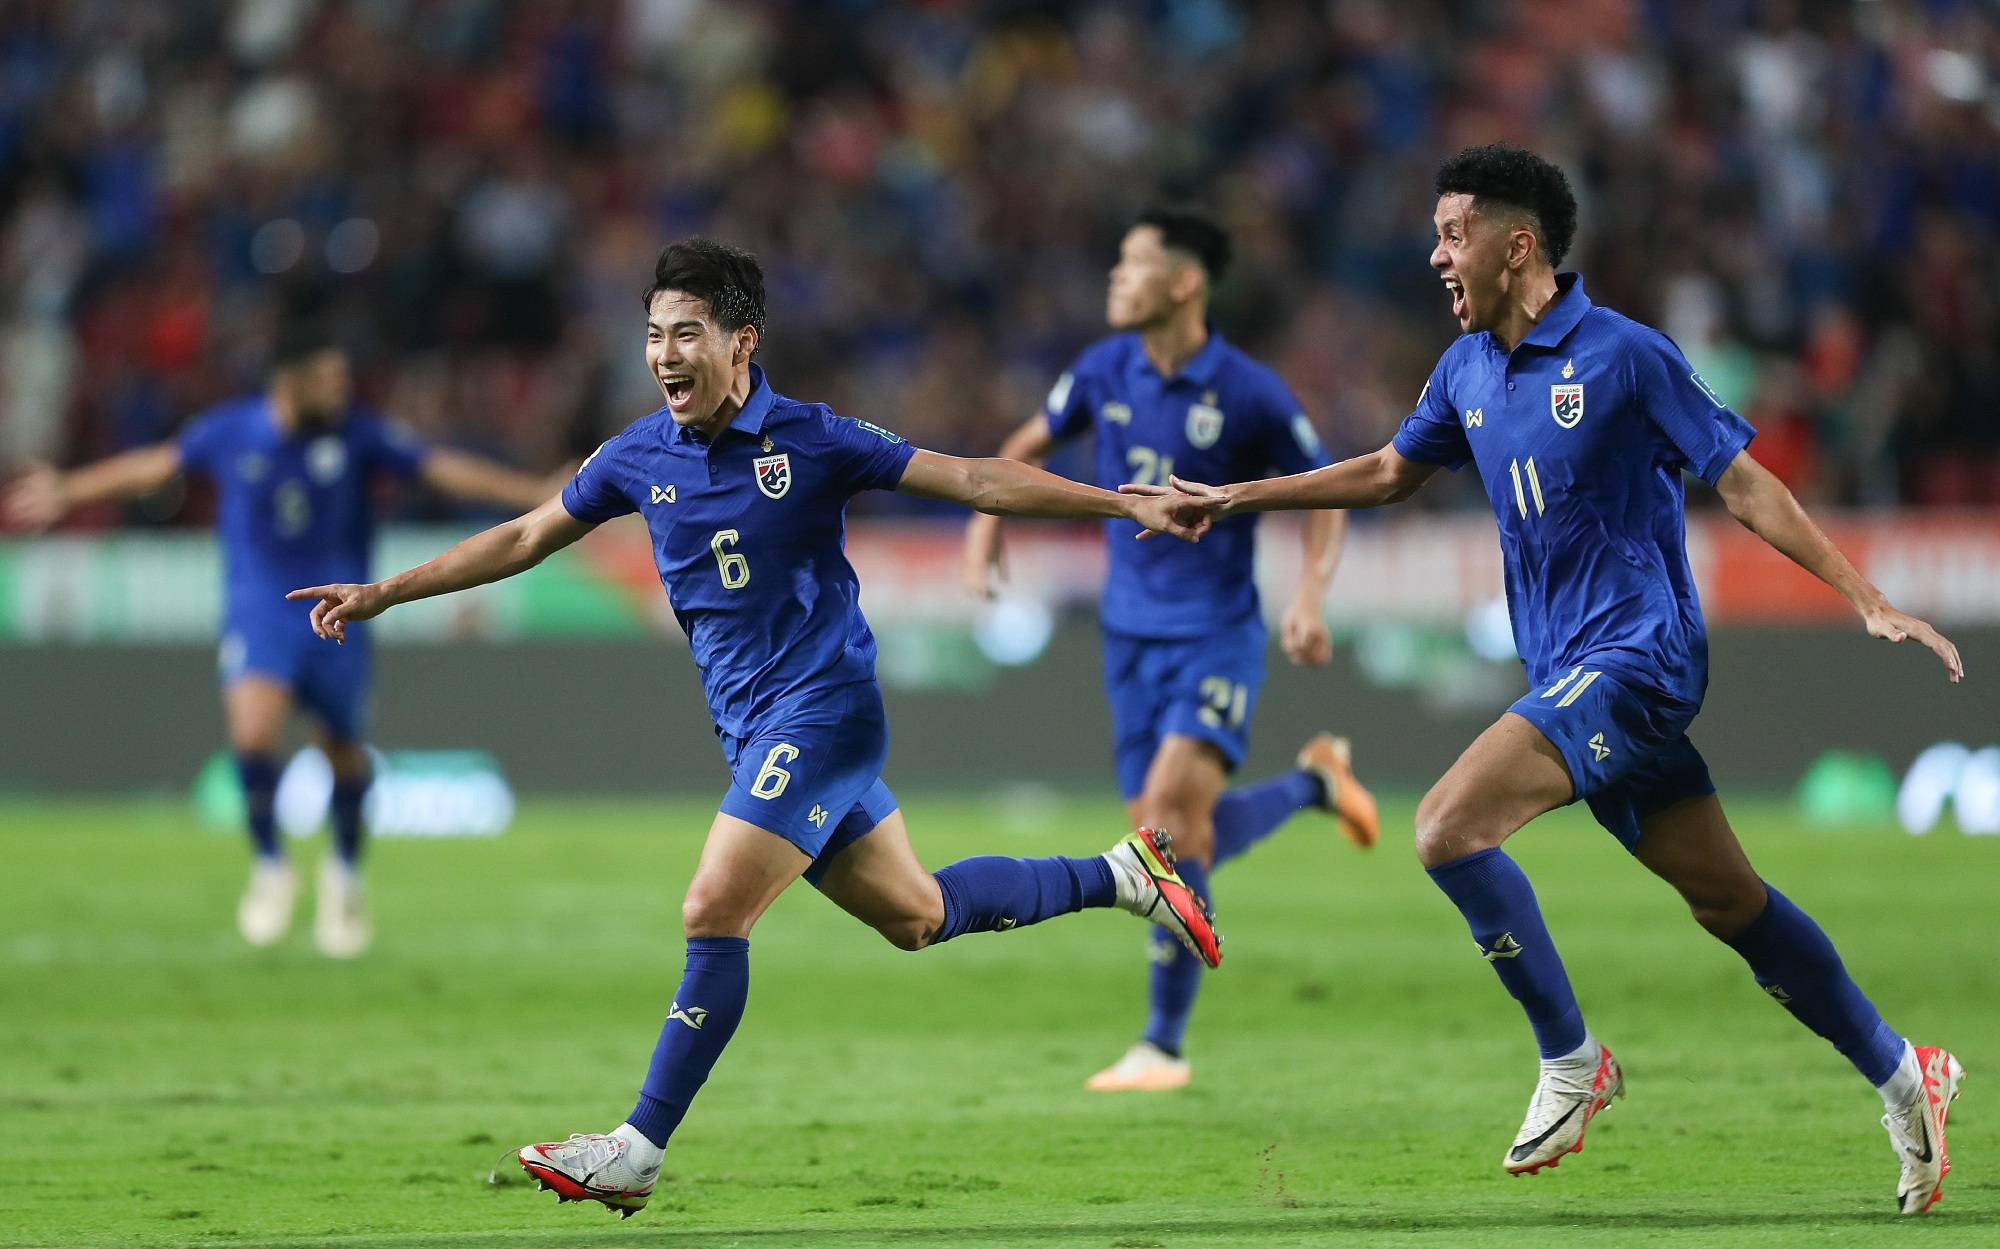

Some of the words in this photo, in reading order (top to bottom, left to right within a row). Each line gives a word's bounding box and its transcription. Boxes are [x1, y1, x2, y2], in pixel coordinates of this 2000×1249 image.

[757, 457, 785, 466] THAILAND
[1126, 445, 1174, 487] 21
[1509, 456, 1545, 521] 11
[710, 529, 750, 590] 6
[1198, 675, 1248, 730] 21
[1540, 665, 1602, 708] 11
[750, 742, 800, 800] 6
